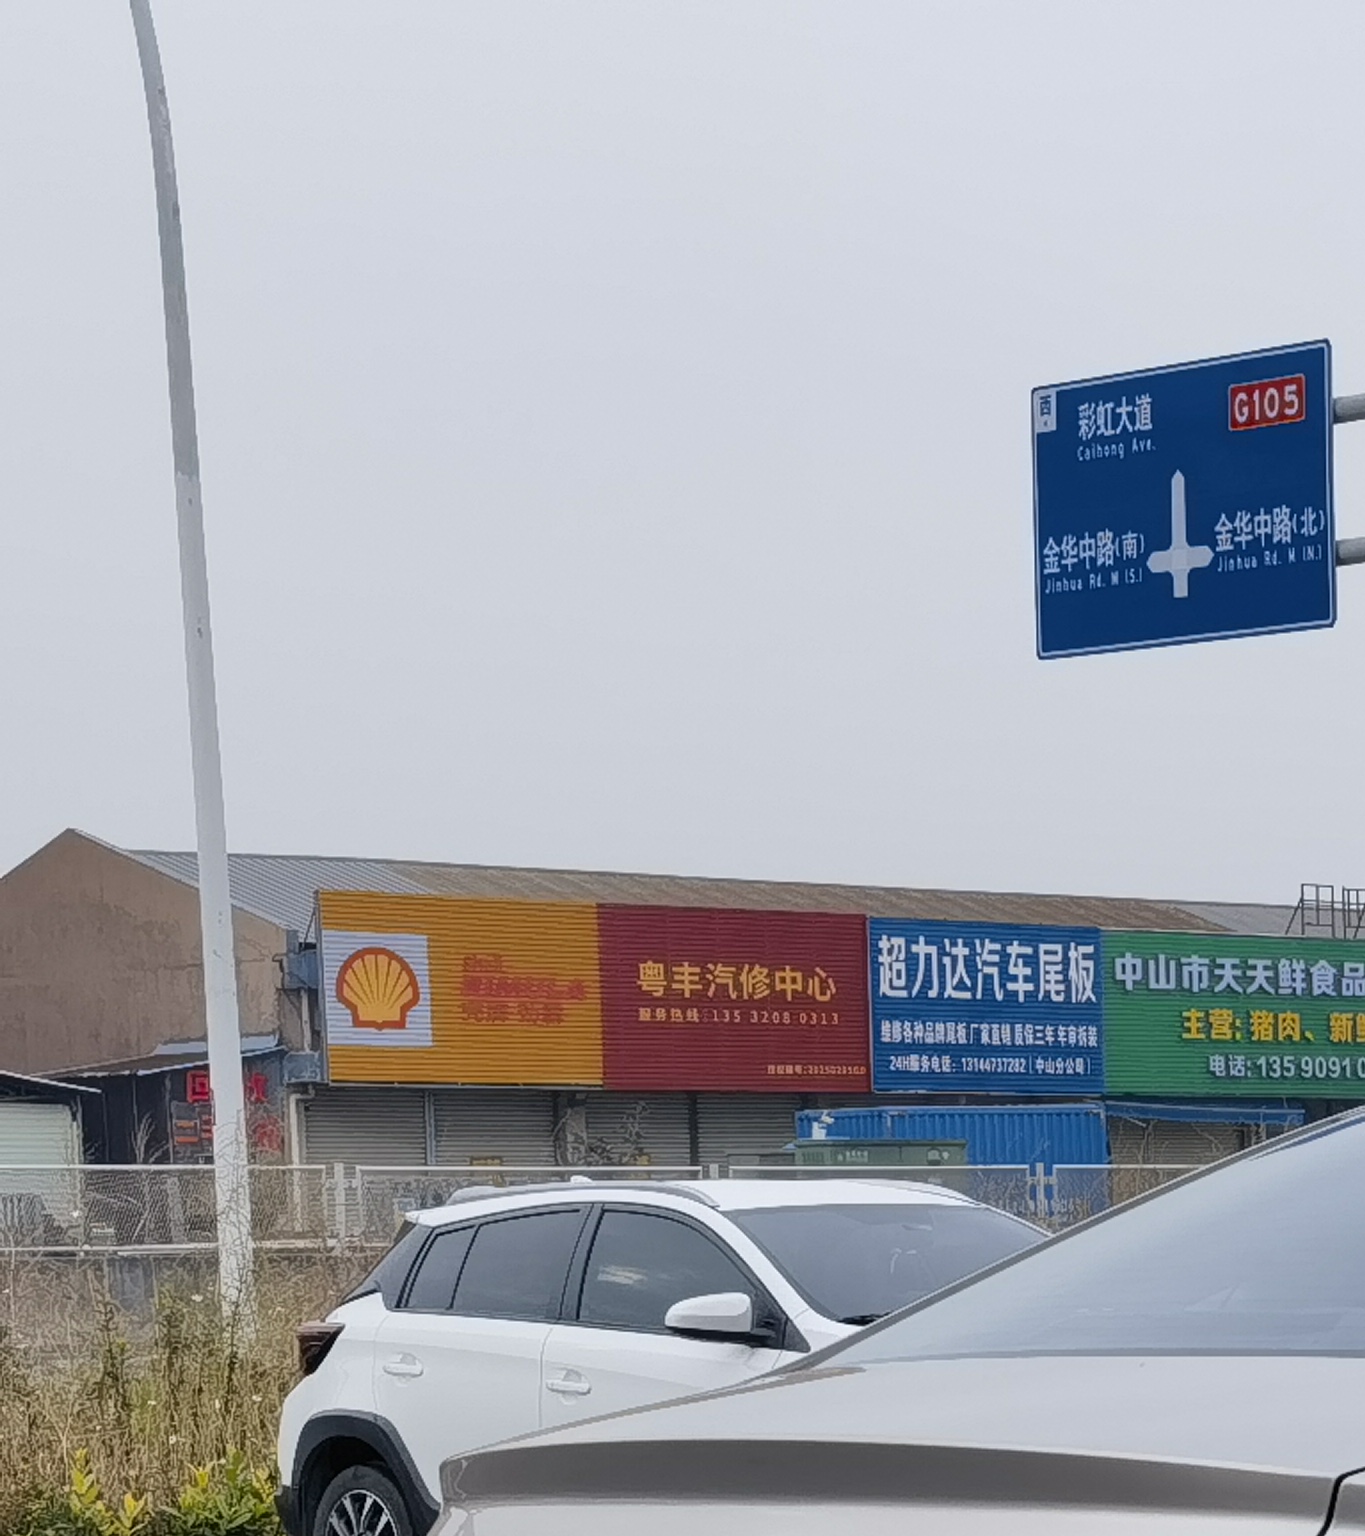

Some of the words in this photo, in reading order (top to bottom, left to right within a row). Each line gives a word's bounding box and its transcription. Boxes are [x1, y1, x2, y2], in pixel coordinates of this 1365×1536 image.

[1077, 394, 1153, 440] 彩虹大道
[1234, 384, 1300, 424] G105
[1077, 441, 1125, 461] Caihong
[1217, 554, 1258, 572] Jinhua
[1045, 574, 1083, 594] Jinhua
[637, 960, 837, 1001] 粤丰汽修中心
[878, 935, 1097, 1003] 超力达汽车尾板
[750, 1010, 791, 1025] 3208
[800, 1011, 840, 1025] 0313
